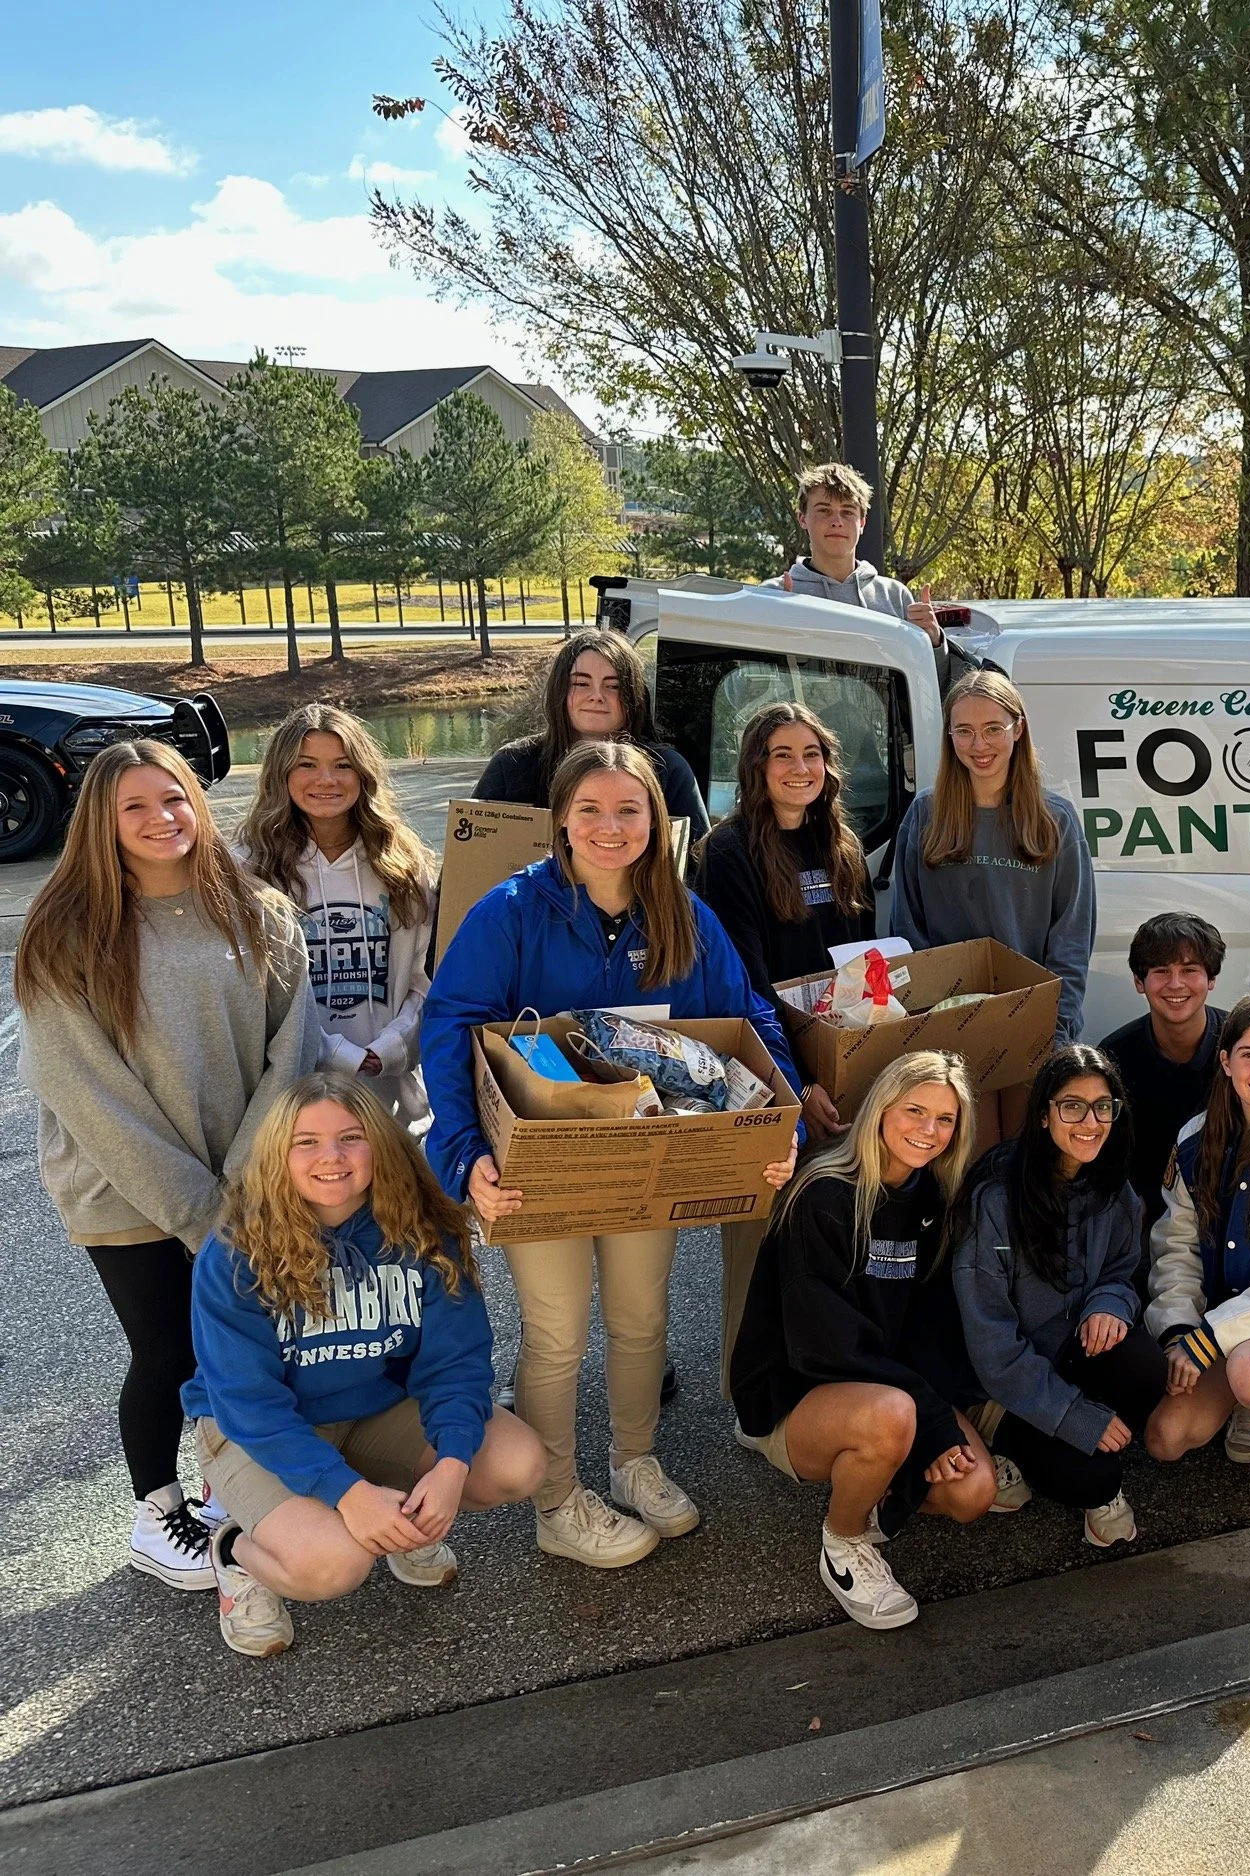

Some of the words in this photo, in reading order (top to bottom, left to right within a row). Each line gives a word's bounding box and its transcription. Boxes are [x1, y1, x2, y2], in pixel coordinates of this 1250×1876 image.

[1109, 689, 1214, 720] Greene
[502, 812, 534, 822] Containers
[474, 826, 498, 834] General
[991, 857, 1040, 874] ACADEMY
[308, 941, 388, 972] TATE
[331, 997, 354, 1006] 2022
[734, 1112, 782, 1128] 05664
